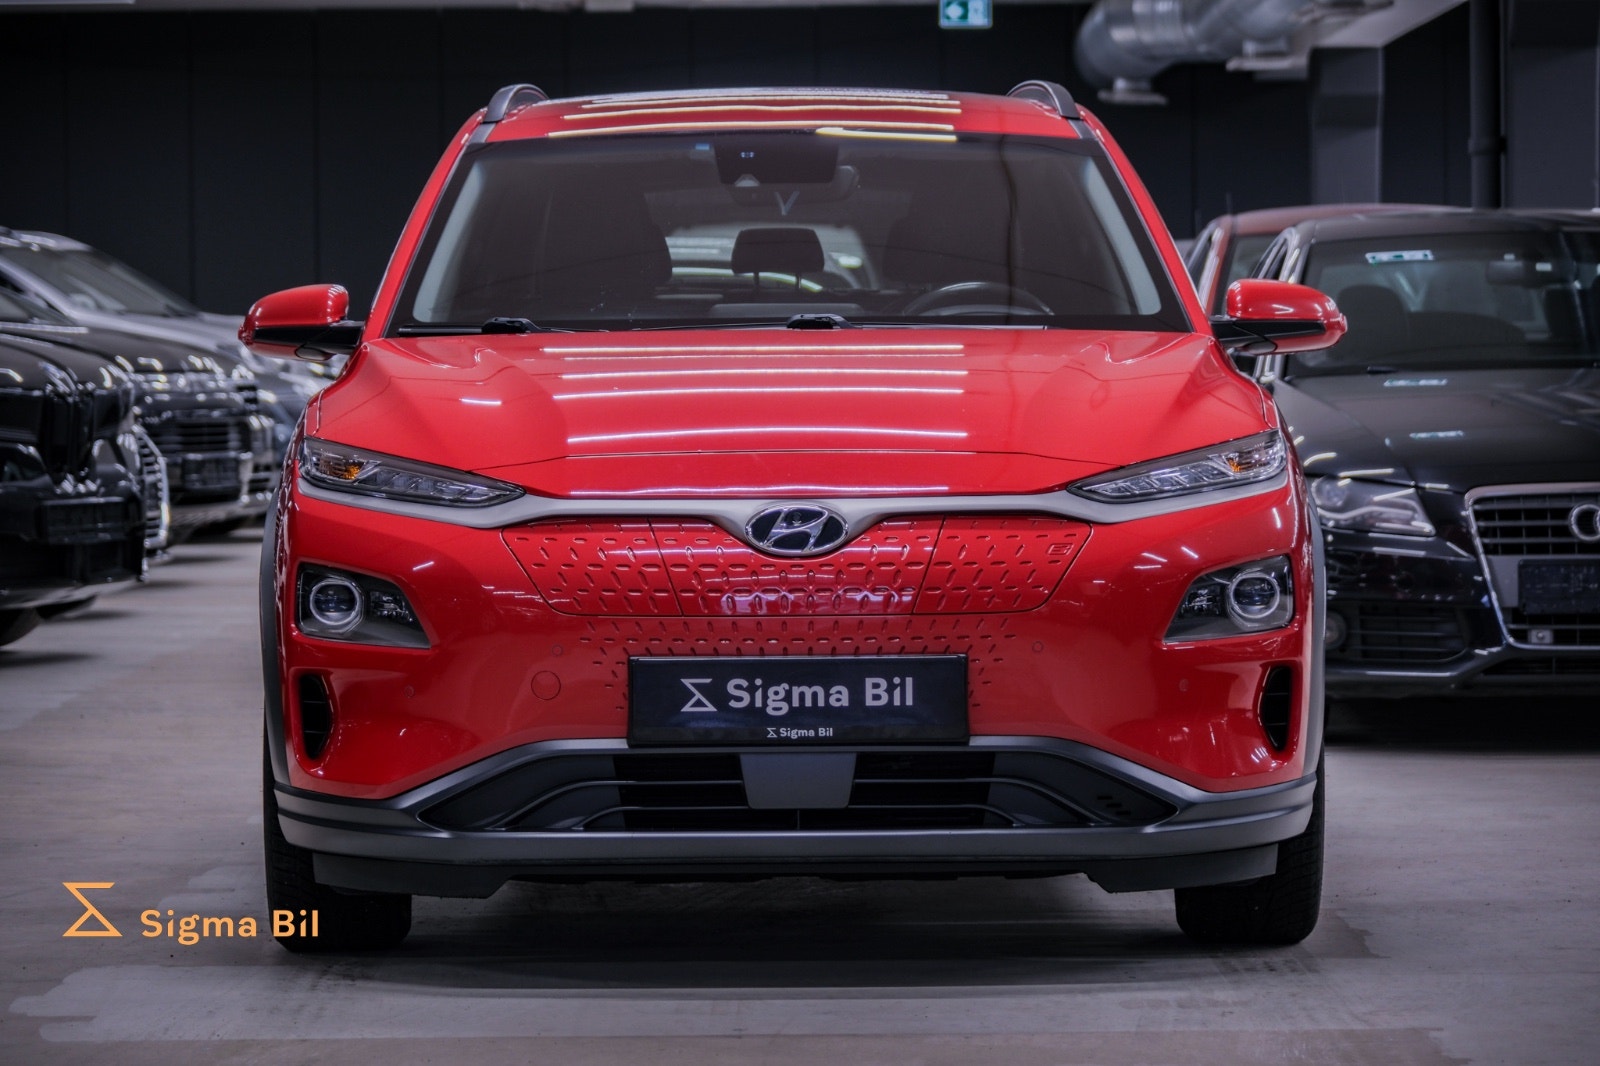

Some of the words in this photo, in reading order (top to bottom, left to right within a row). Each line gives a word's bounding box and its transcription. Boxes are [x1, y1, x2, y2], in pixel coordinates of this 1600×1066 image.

[726, 678, 850, 716] Sigma
[865, 677, 914, 706] Bil
[780, 727, 815, 739] Sigma
[818, 727, 833, 737] Bil
